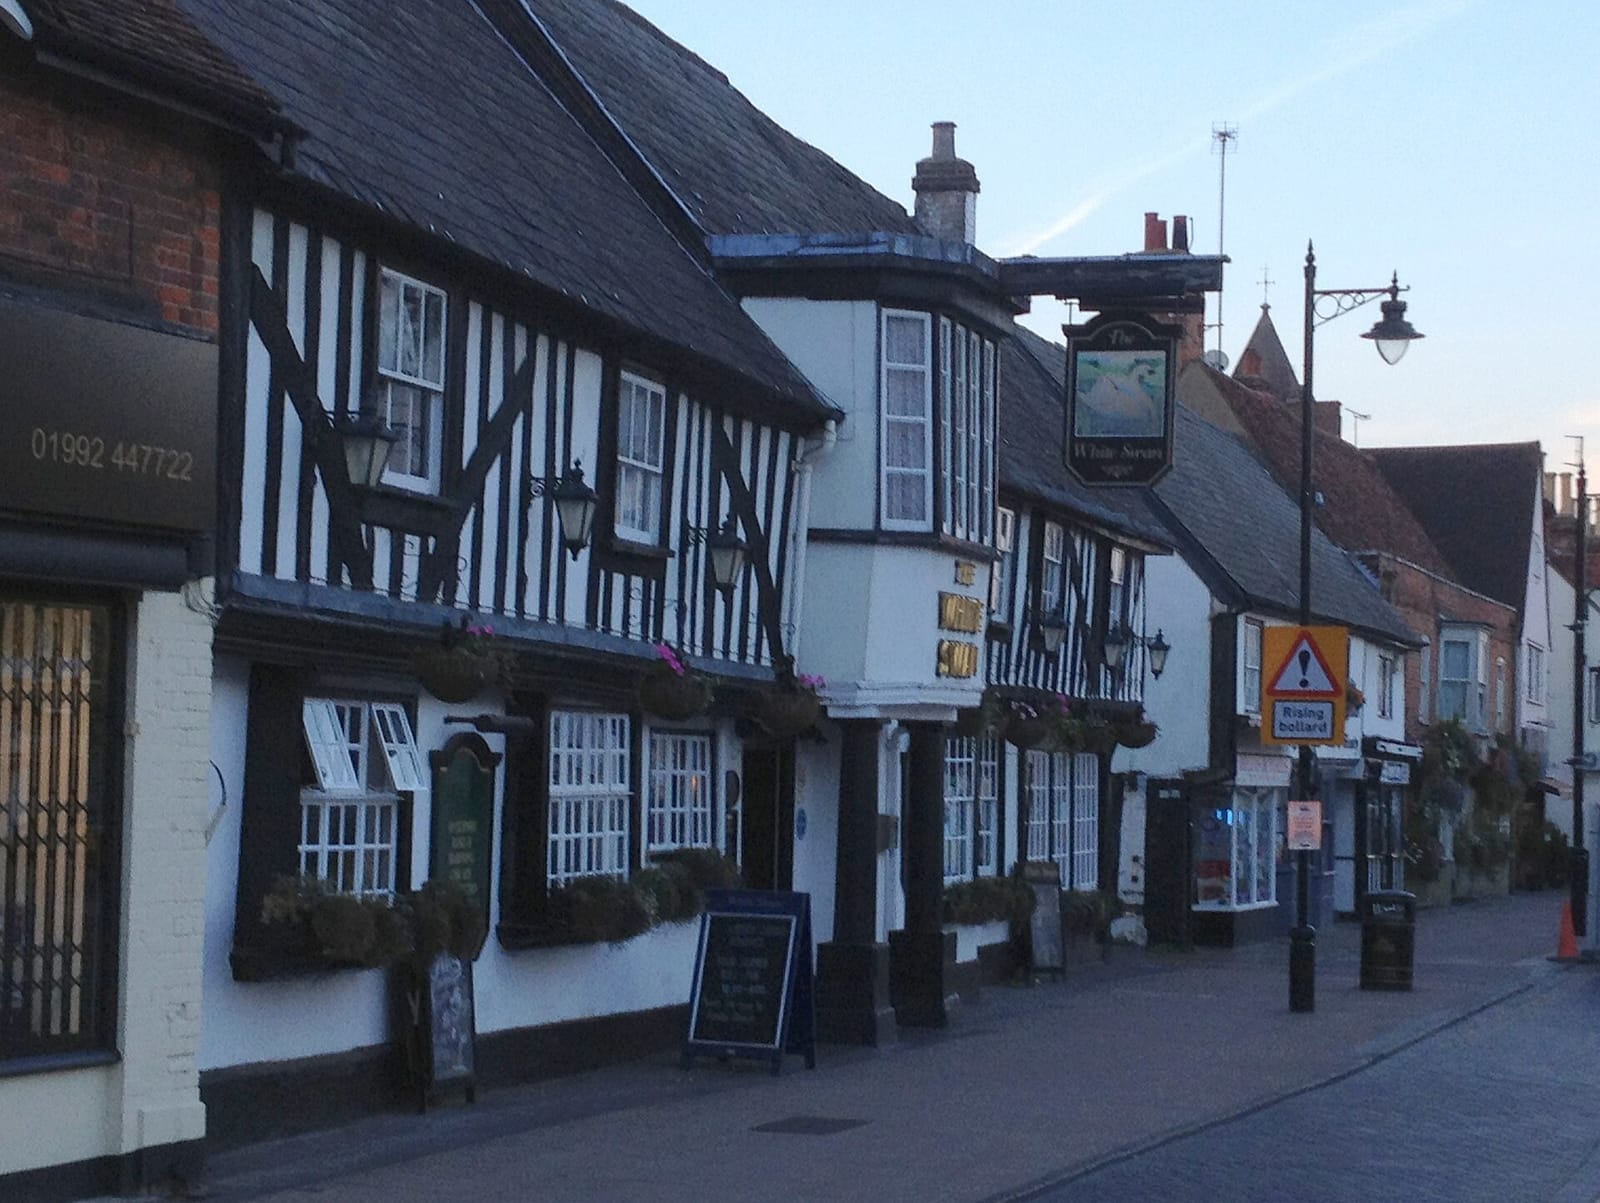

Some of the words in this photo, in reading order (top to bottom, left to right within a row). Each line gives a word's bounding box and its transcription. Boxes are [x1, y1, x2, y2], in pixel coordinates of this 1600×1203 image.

[31, 428, 105, 468] 01992
[111, 442, 193, 481] 447722
[1282, 706, 1325, 721] Rising
[1278, 720, 1328, 733] bollard
